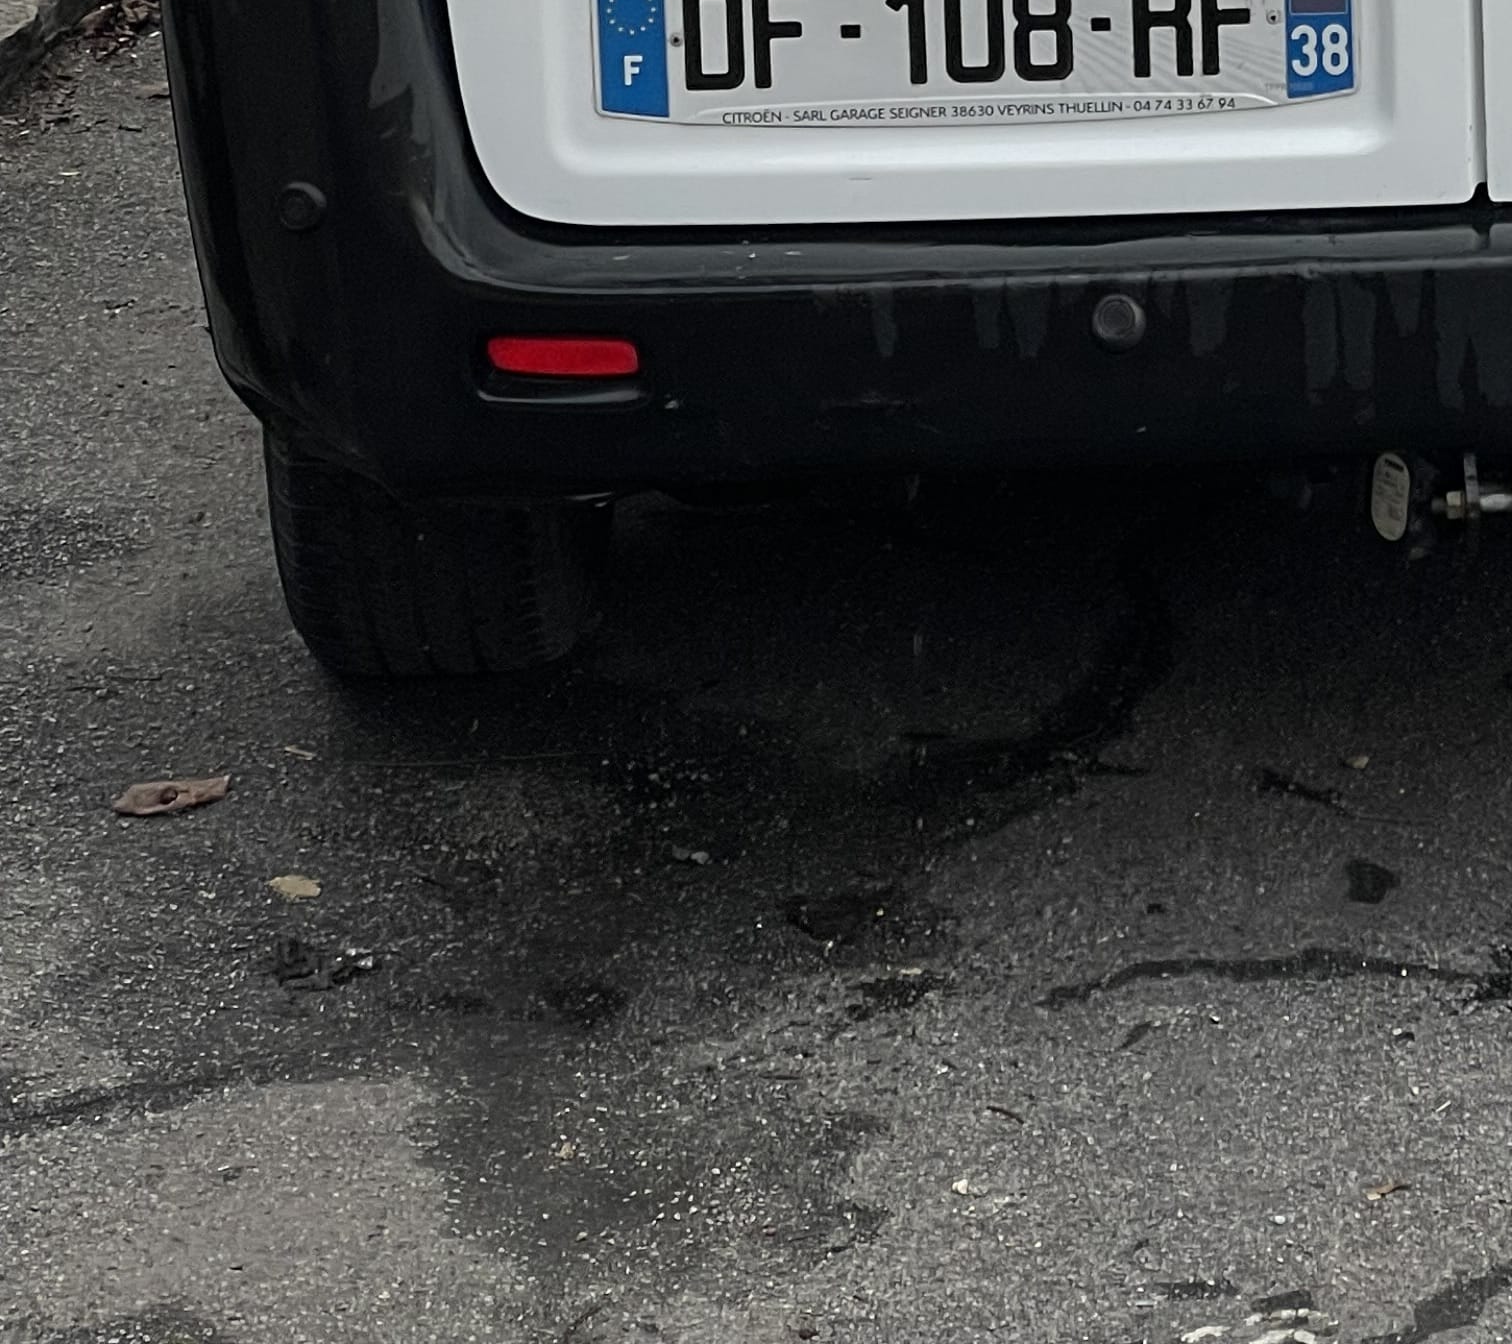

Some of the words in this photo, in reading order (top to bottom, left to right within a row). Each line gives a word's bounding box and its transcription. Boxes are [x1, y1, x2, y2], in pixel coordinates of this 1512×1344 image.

[1291, 23, 1349, 77] 38
[623, 55, 643, 86] F
[722, 108, 782, 124] CITROËN
[793, 110, 827, 123] SARL
[830, 108, 885, 121] GARAGE
[889, 106, 947, 120] SEIGNER
[951, 105, 994, 118] 38630
[997, 103, 1055, 116] VEYRINS
[1058, 101, 1123, 113] THUELLIN
[1133, 100, 1151, 112] 04
[1155, 99, 1172, 111] 74
[1176, 98, 1193, 111] 33
[1197, 97, 1214, 110] 67
[1218, 97, 1236, 109] 94
